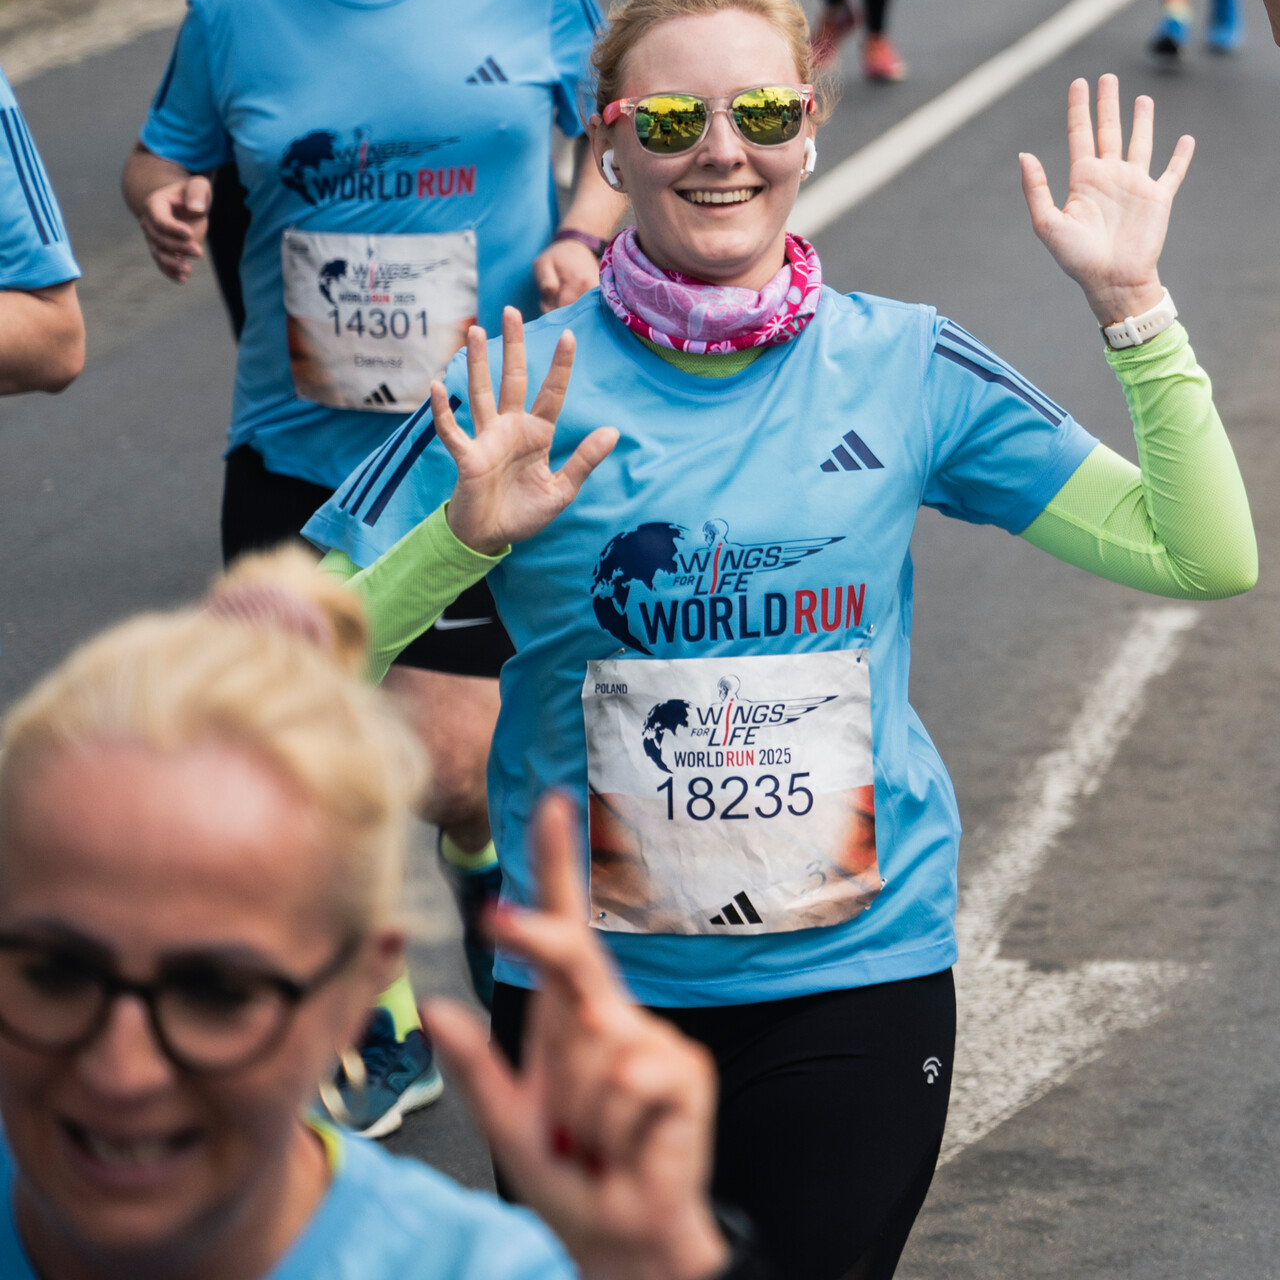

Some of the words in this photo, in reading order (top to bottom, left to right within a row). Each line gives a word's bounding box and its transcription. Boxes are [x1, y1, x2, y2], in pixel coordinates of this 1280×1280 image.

[312, 170, 413, 203] WORLD
[417, 165, 476, 199] RUN
[328, 307, 428, 339] 14301
[673, 575, 695, 587] FOR
[693, 572, 753, 597] LIFE
[639, 591, 787, 646] WORLD
[794, 583, 866, 635] RUN
[594, 683, 628, 695] POLAND
[690, 727, 710, 737] FOR
[707, 726, 761, 747] LIFE
[673, 751, 724, 768] WORLD
[726, 750, 755, 767] RUN
[759, 748, 792, 766] 2025
[656, 772, 814, 821] 18235
